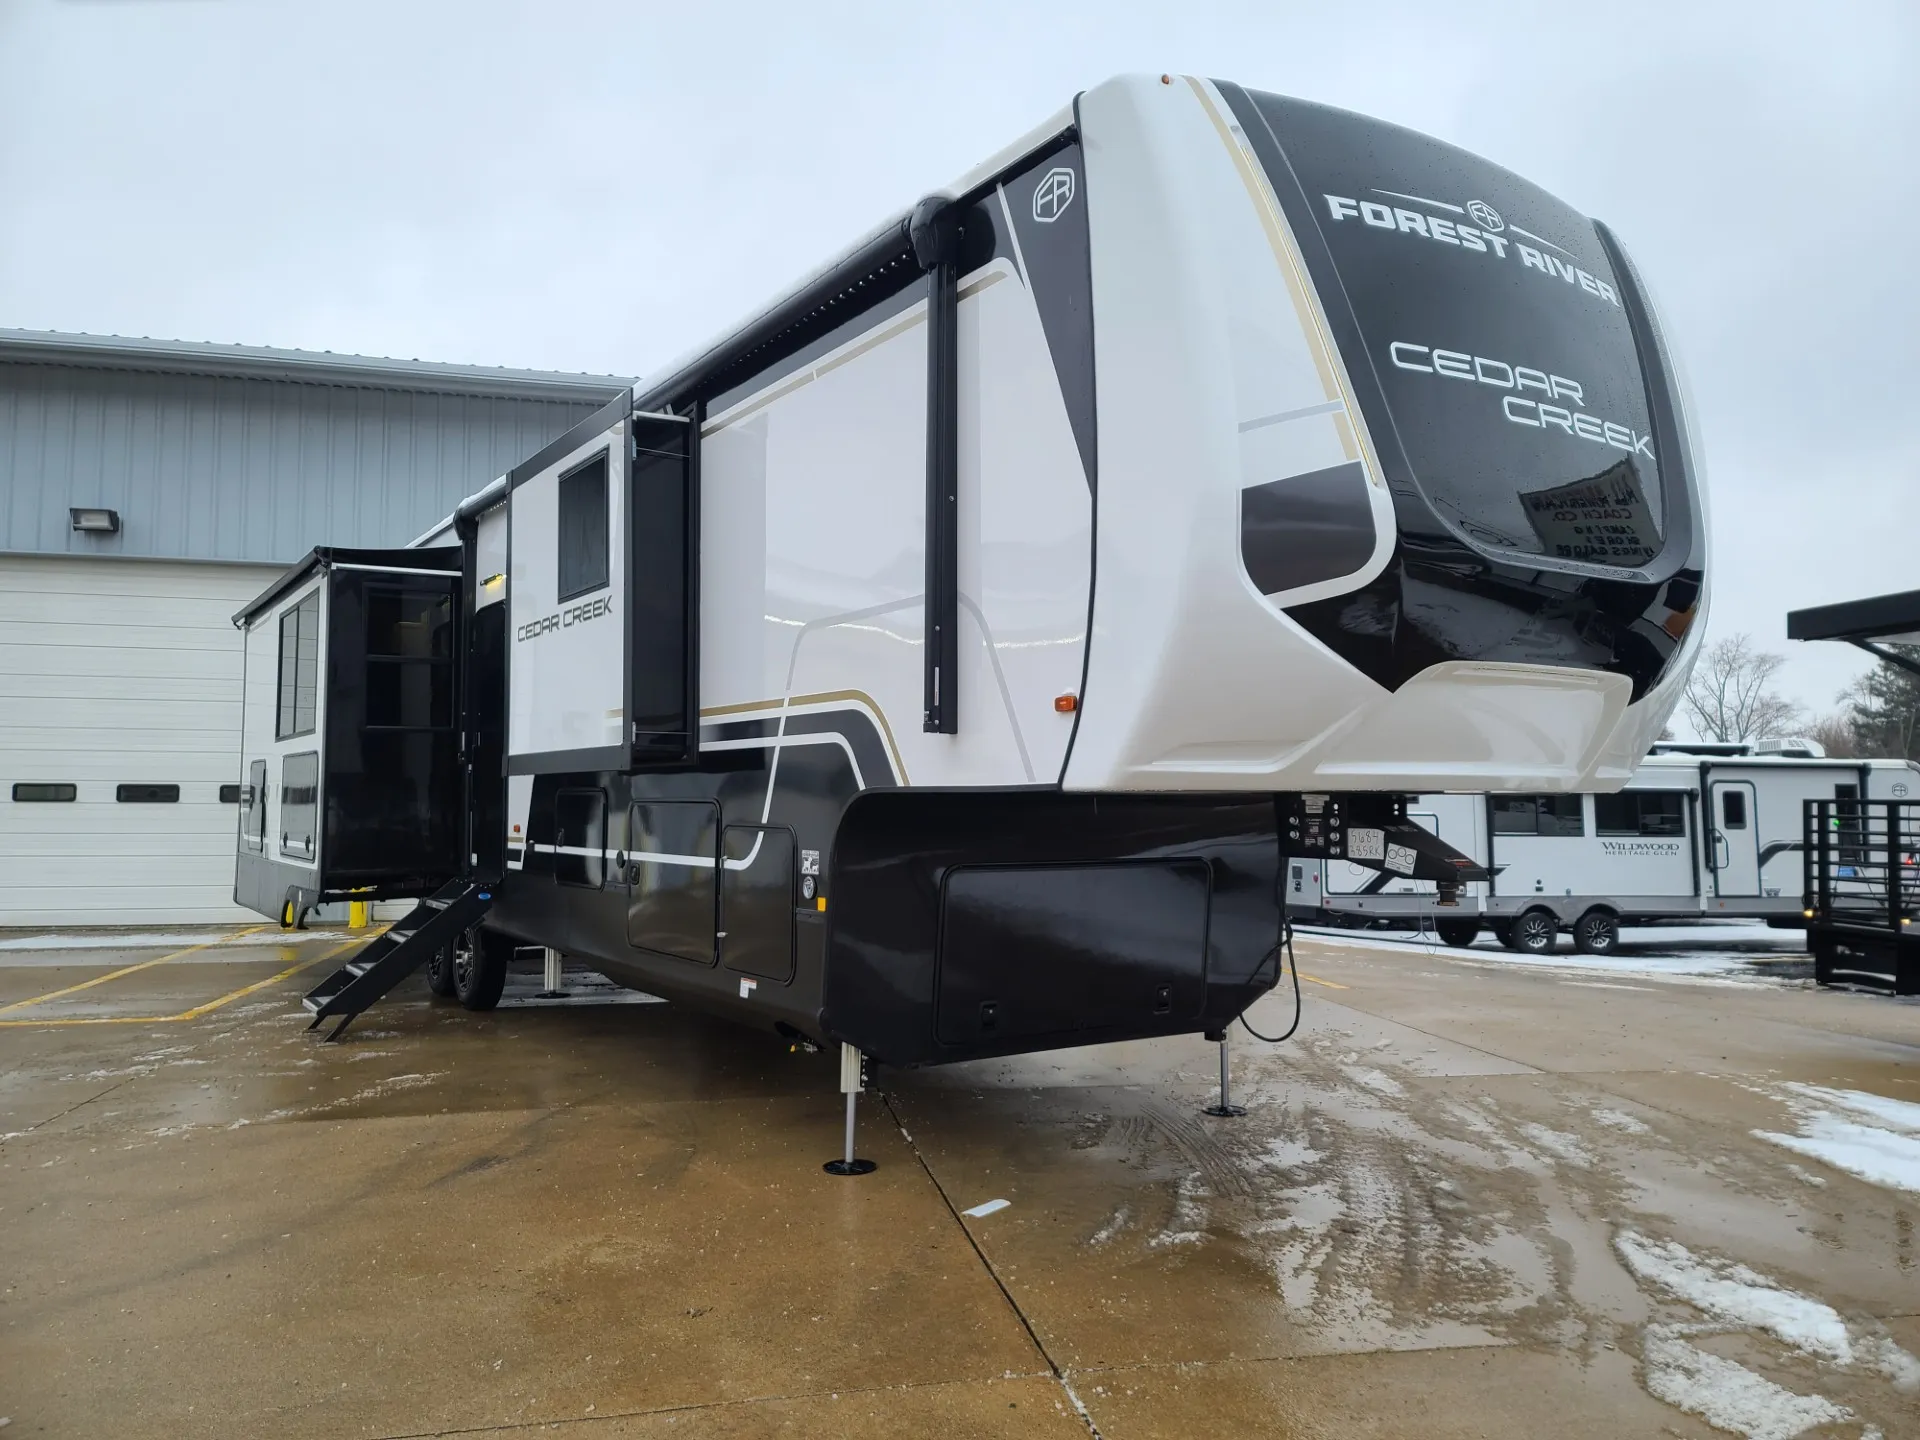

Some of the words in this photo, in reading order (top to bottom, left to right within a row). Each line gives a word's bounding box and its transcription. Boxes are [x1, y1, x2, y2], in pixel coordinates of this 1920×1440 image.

[1323, 194, 1508, 258] FOREST
[1516, 243, 1621, 307] RIVER
[1390, 341, 1585, 407] CEDAR
[1503, 396, 1655, 460] CREEK
[518, 613, 560, 642] CEDAR
[563, 595, 613, 628] CREEK
[1602, 842, 1680, 851] WILDWOOD
